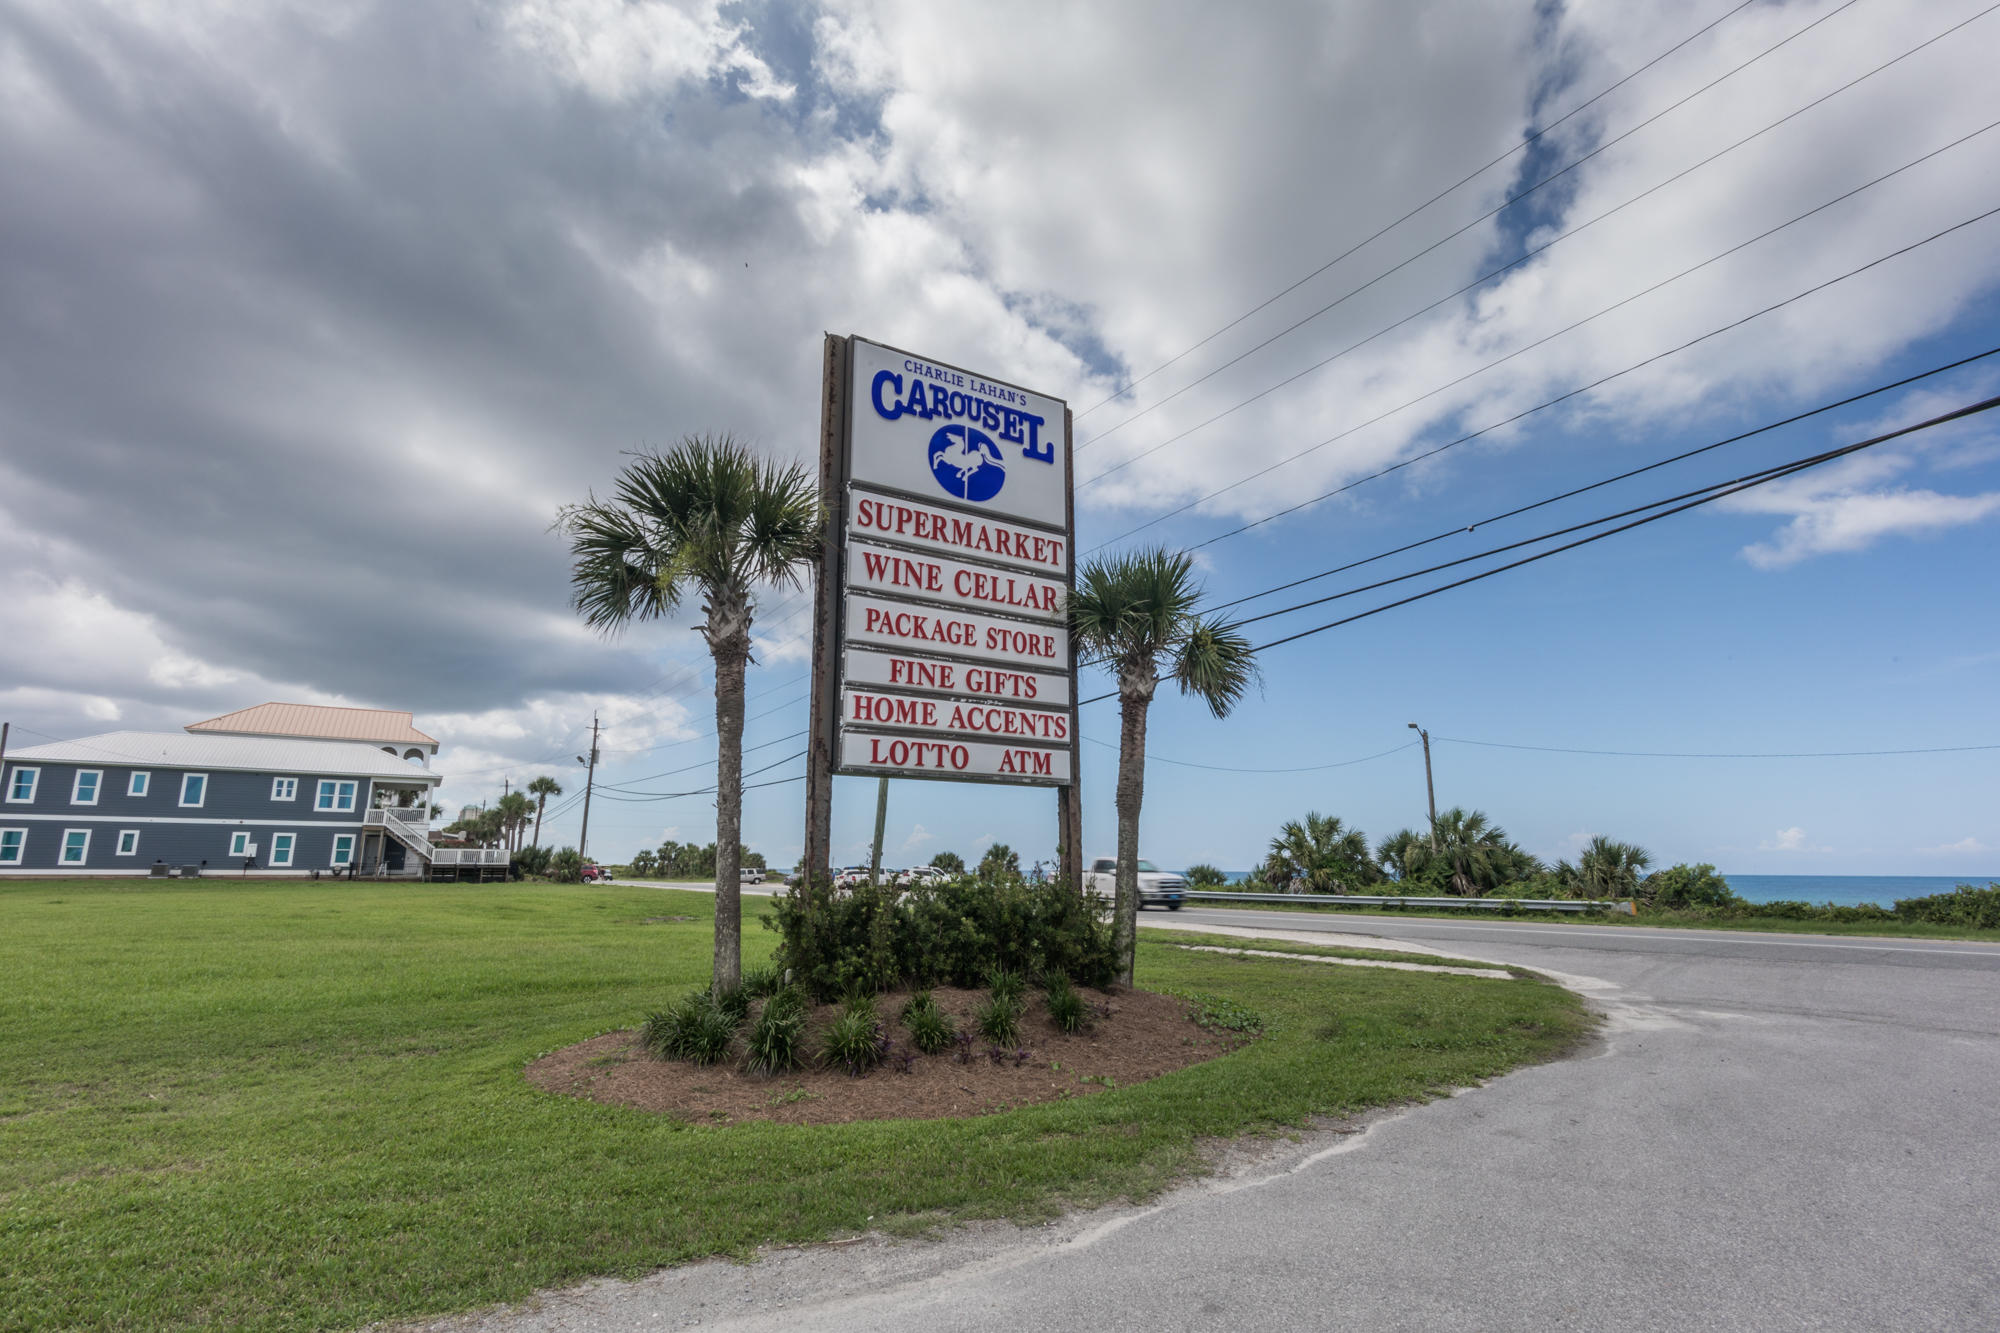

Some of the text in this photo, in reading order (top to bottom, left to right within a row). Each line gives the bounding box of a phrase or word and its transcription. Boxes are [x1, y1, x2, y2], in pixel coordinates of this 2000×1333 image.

[904, 360, 1027, 406] CHARLIE LAHAN'S
[871, 369, 1055, 465] CAROUSEL
[857, 499, 1064, 566] SUPERMARKET
[863, 552, 1059, 613] WINE CELLAR
[865, 607, 1056, 658] PACKAGE STORE
[889, 658, 1038, 699] FINE GIFTS
[853, 694, 1067, 739] HOME ACCENTS
[870, 738, 1053, 775] LOTTO ATM
